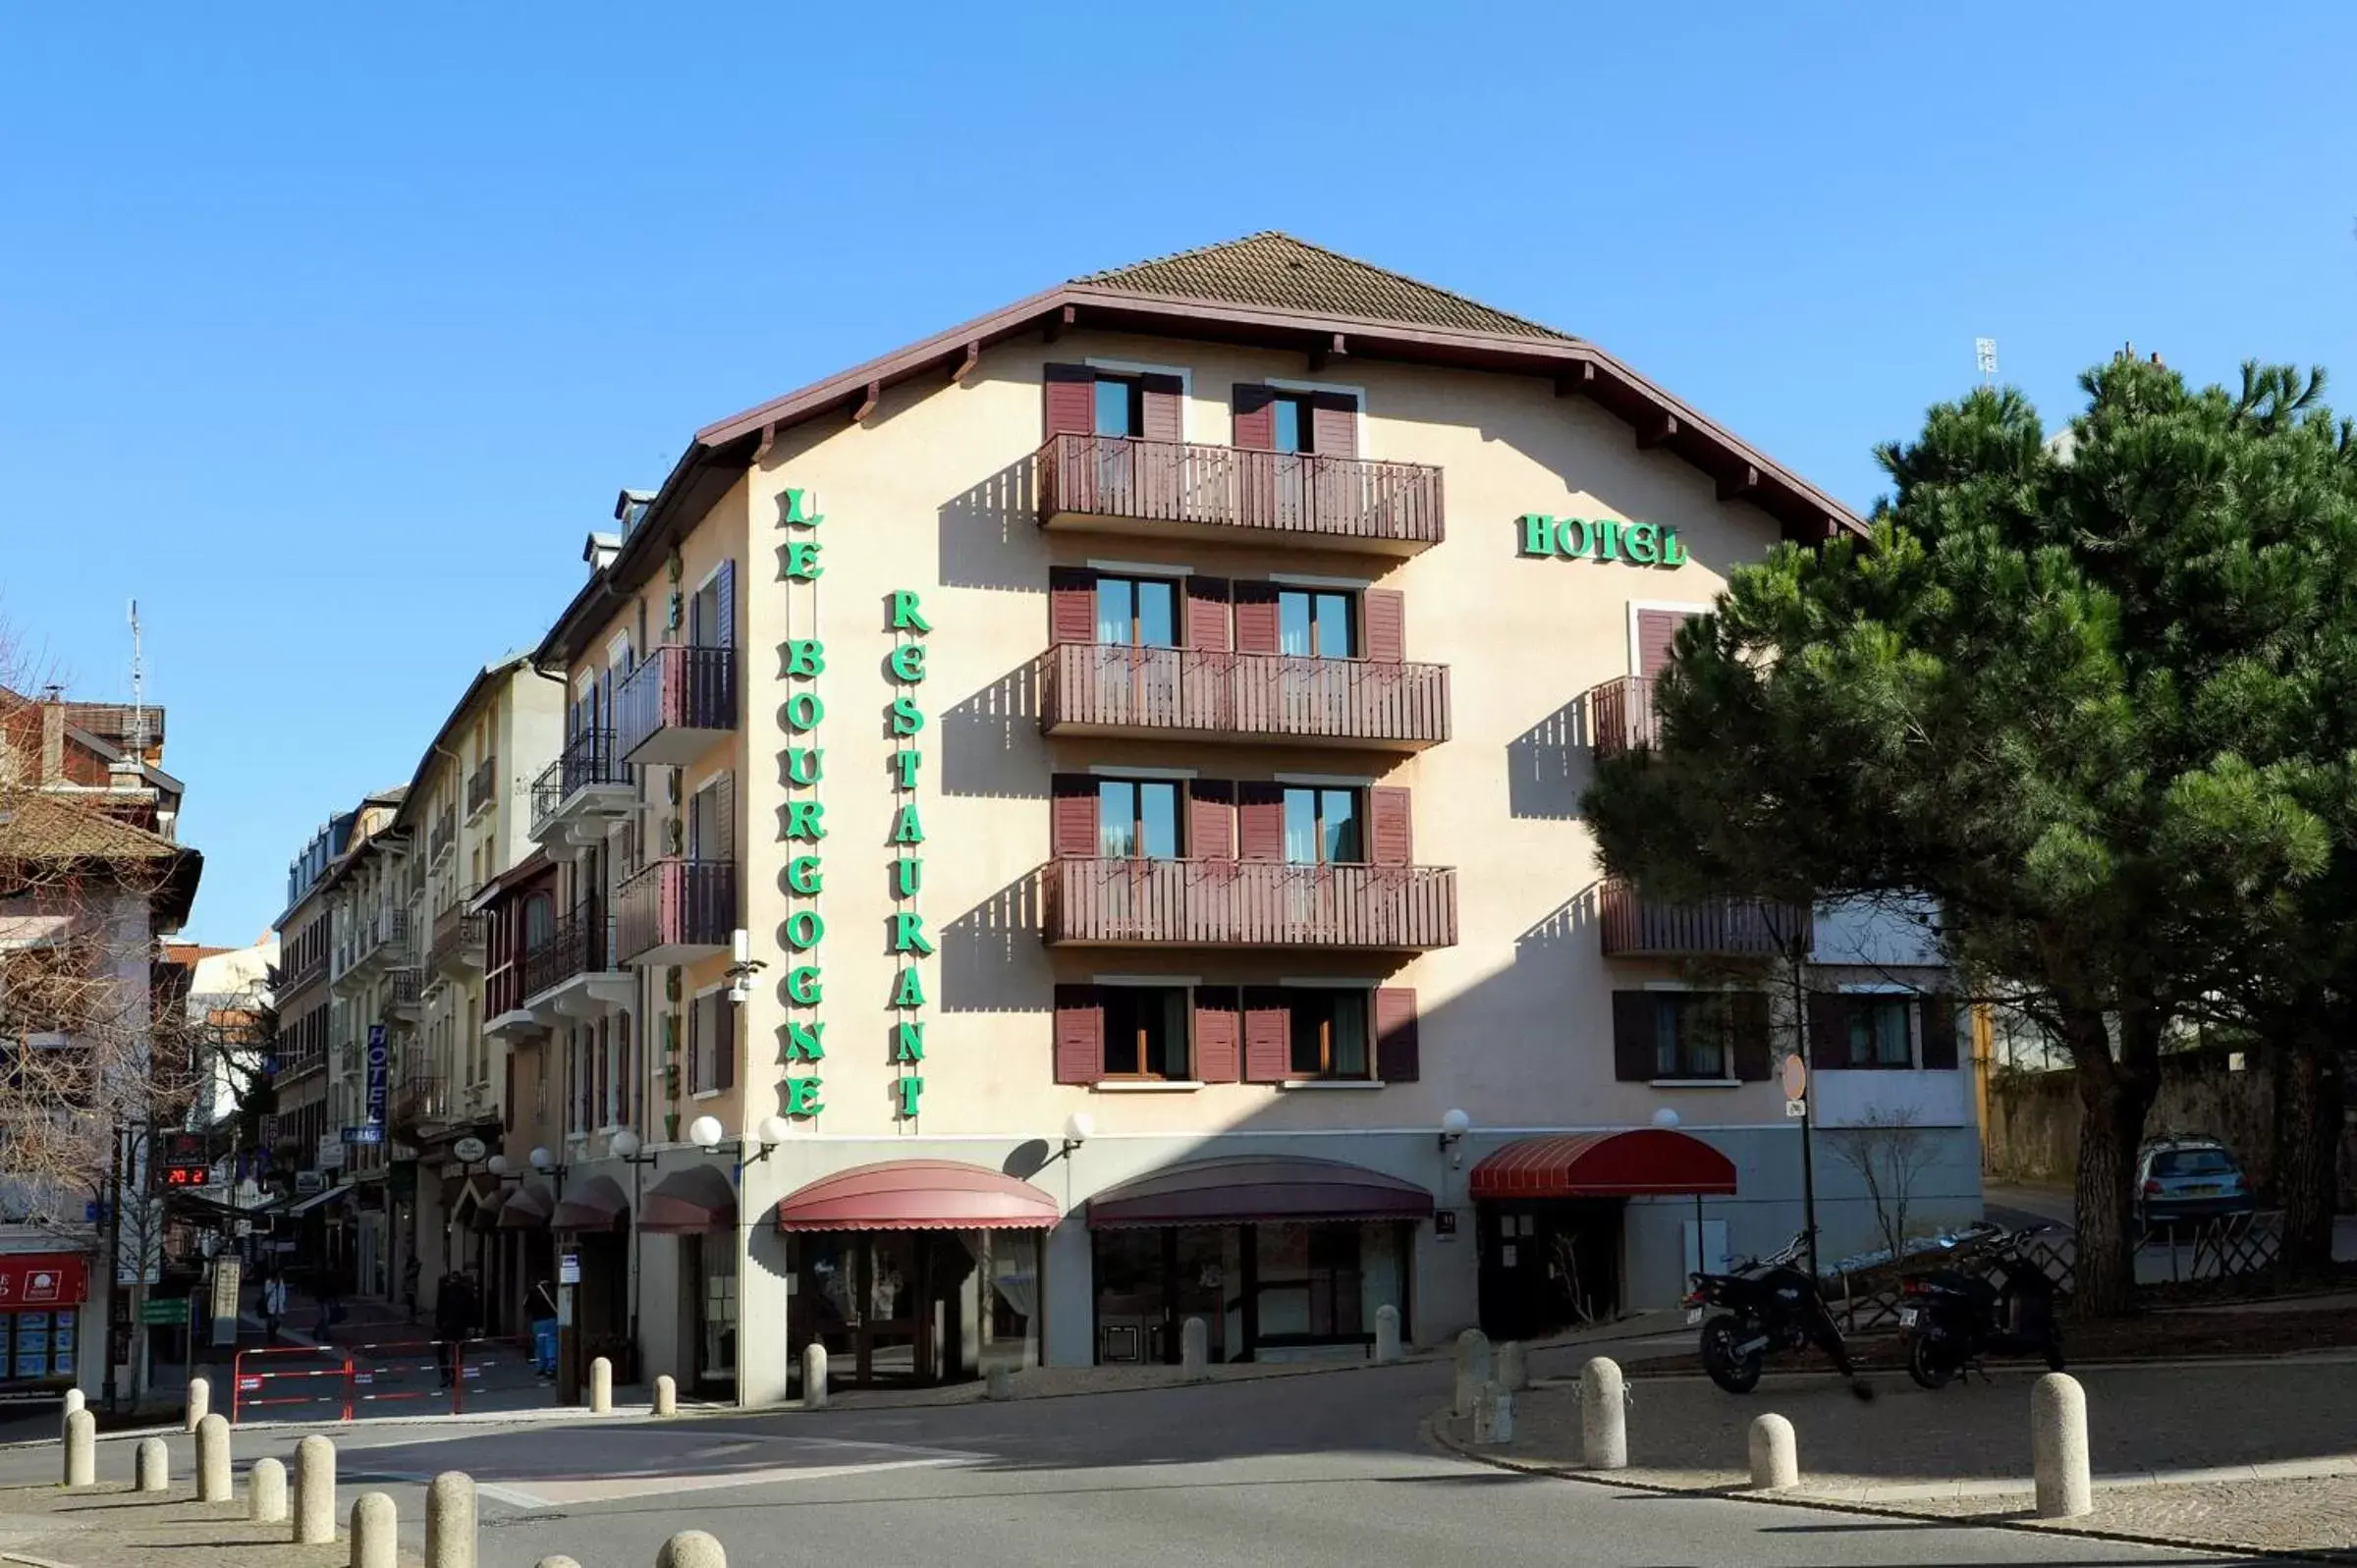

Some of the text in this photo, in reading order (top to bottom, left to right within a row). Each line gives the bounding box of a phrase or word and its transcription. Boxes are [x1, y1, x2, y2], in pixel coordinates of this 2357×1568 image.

[1523, 512, 1690, 567] HOTEL
[784, 488, 828, 1116] LE BOURGOGNE
[891, 589, 935, 1116] RESTAURANT
[367, 1027, 387, 1123] HOTEL
[344, 1129, 384, 1142] GARAGE
